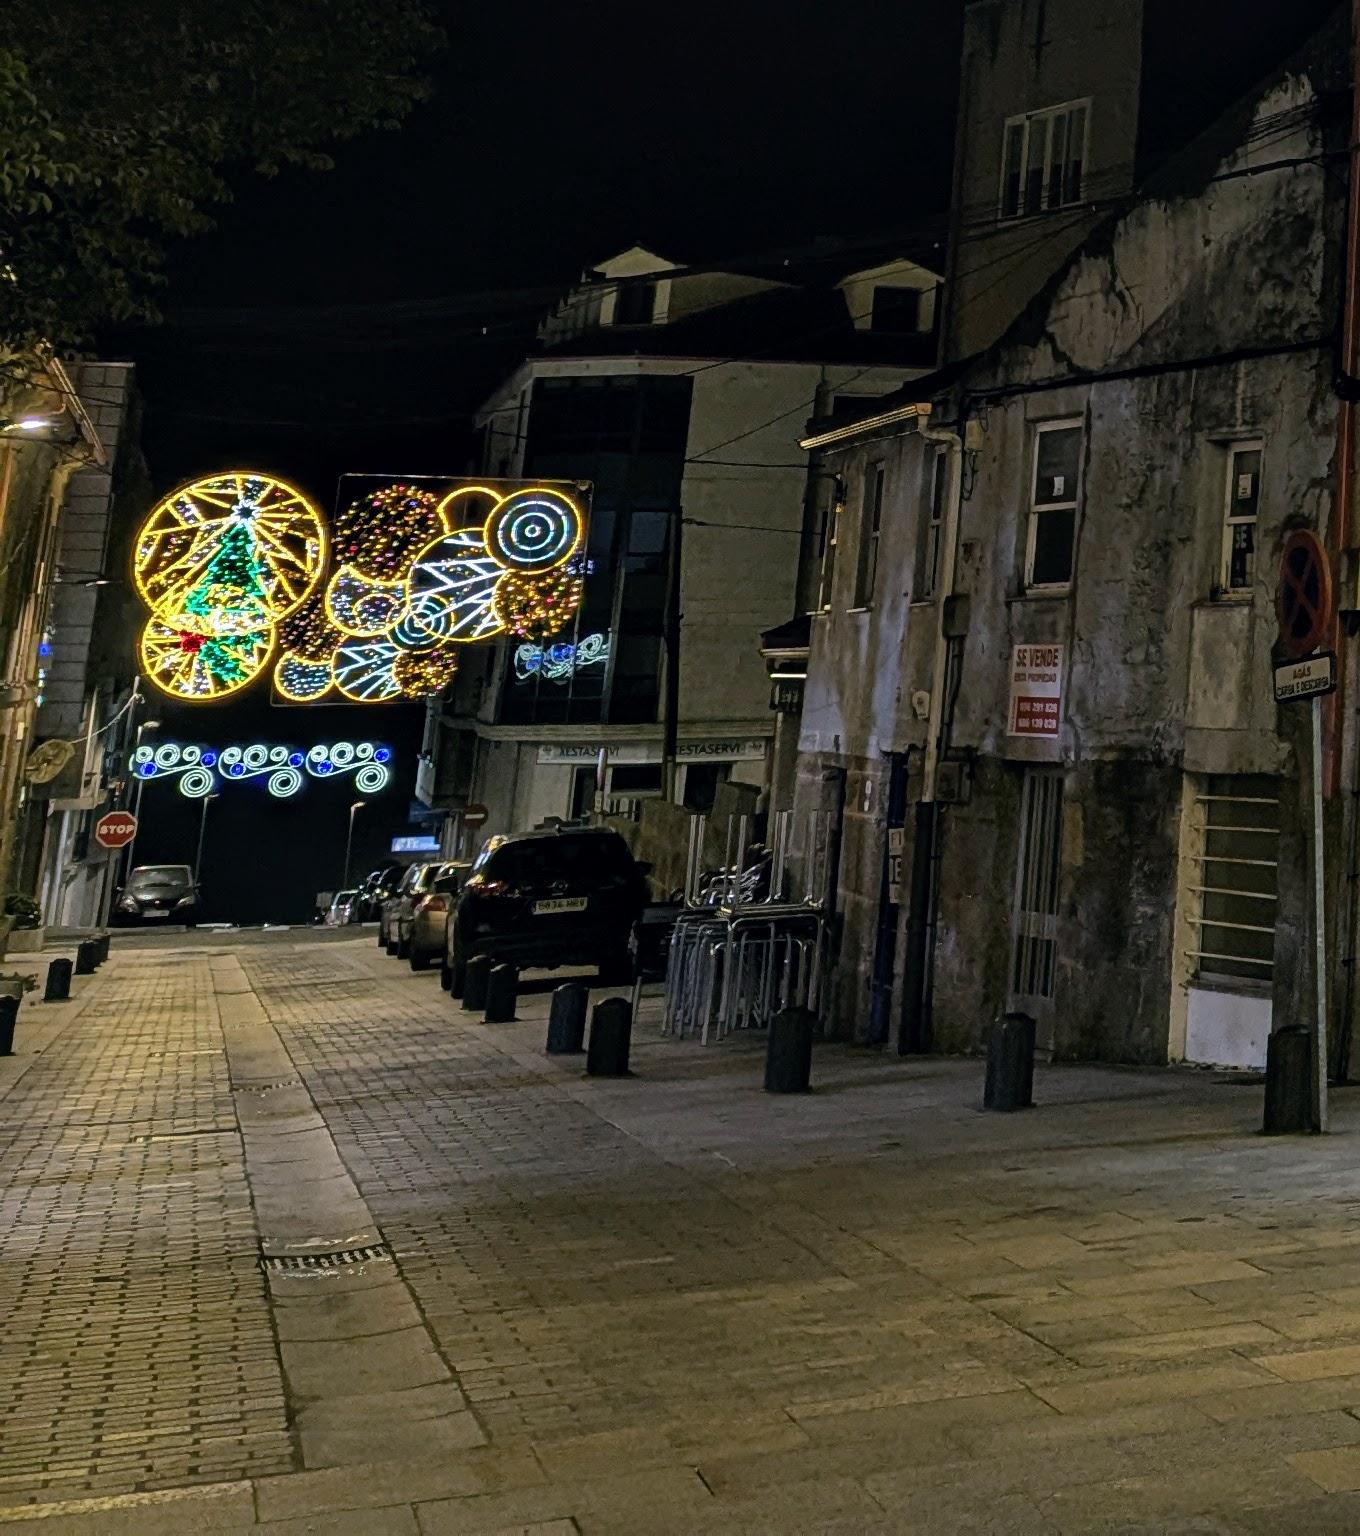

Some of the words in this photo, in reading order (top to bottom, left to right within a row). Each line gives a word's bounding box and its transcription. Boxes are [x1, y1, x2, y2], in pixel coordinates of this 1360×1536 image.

[1016, 648, 1027, 668] SE
[1029, 648, 1059, 668] VENDE
[676, 744, 741, 756] ESTASERVI
[100, 825, 135, 834] STOP
